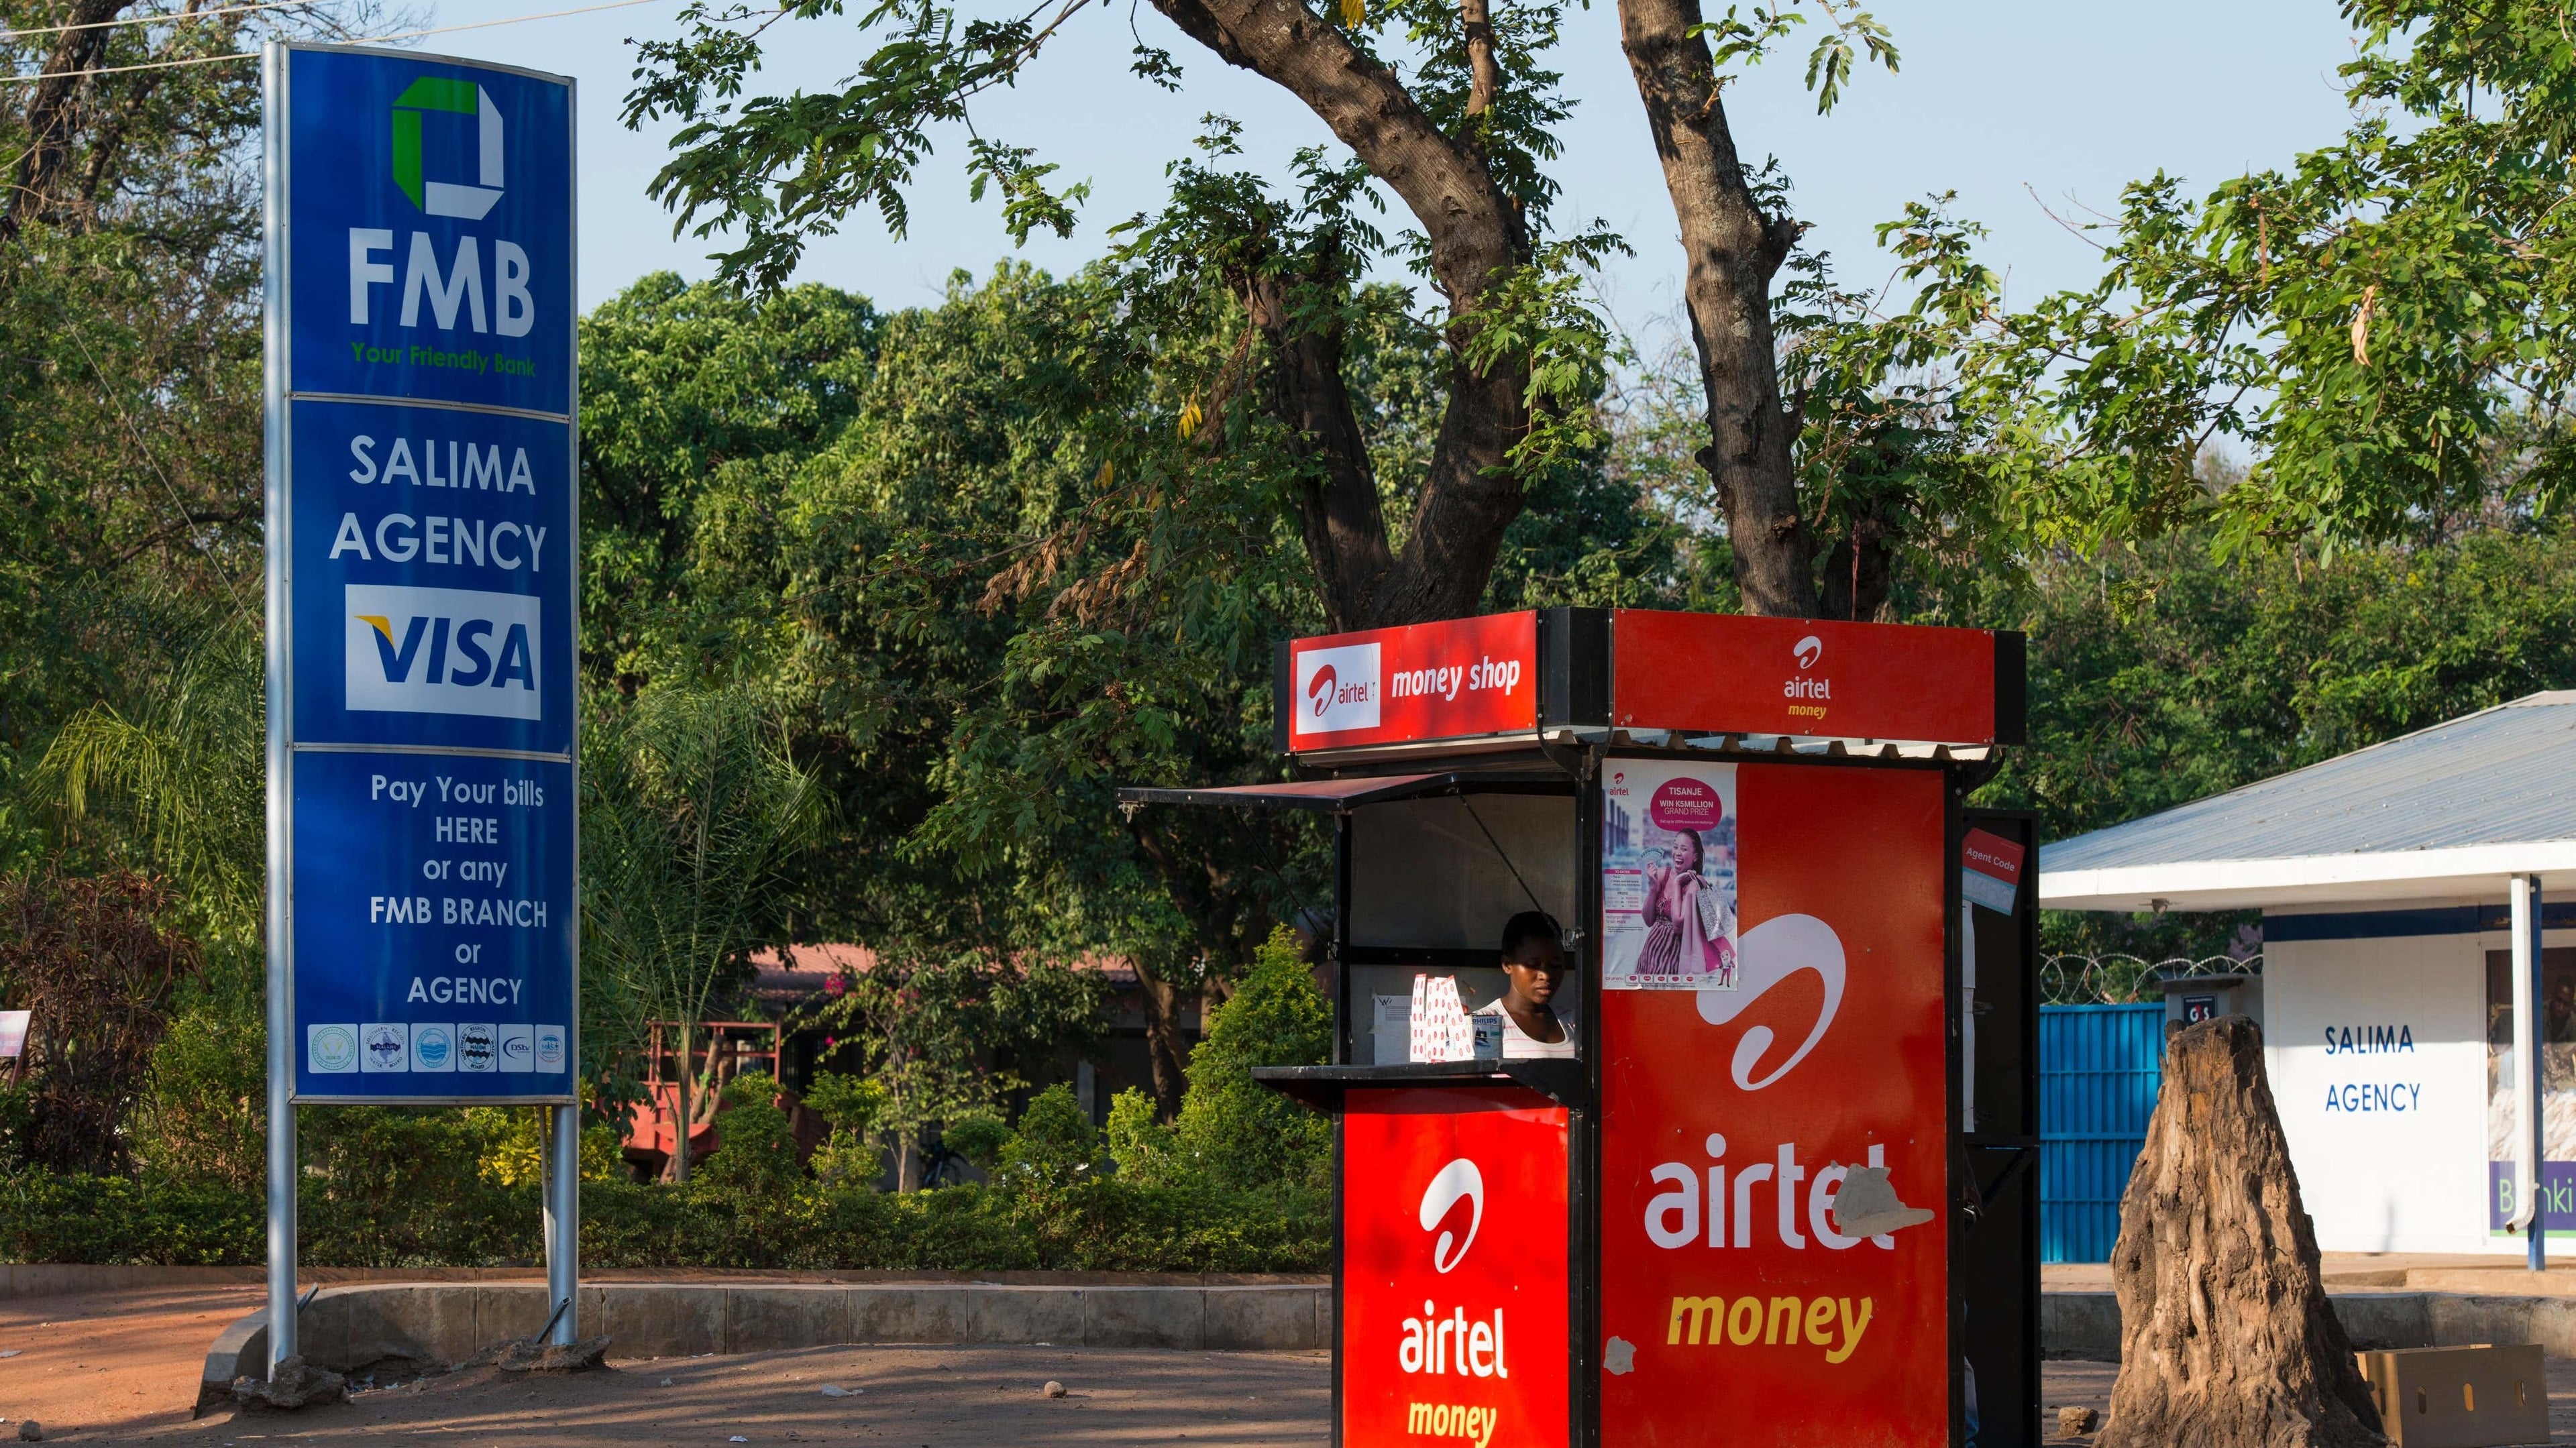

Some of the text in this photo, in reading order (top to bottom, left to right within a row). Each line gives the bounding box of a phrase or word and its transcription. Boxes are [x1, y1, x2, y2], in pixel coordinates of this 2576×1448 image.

[350, 227, 535, 337] FMB
[351, 342, 536, 377] Your Friendly Bank
[349, 435, 536, 495] SALIMA
[329, 512, 546, 572] AGENCY
[354, 615, 535, 691] VISA
[1338, 683, 1368, 704] airtel
[1391, 656, 1520, 702] money shop
[1784, 676, 1831, 699] airtel
[1788, 705, 1827, 720] money
[372, 775, 543, 807] Pay Your bills
[1609, 787, 1629, 796] airtel
[1669, 787, 1703, 795] TISANJE
[1675, 800, 1713, 808] K5MILLION
[436, 816, 498, 844] HERE
[423, 859, 507, 887] or any
[1966, 847, 2015, 871] Agent Code
[370, 896, 547, 928] FMB BRANCH
[455, 943, 481, 964] or
[407, 977, 522, 1005] AGENCY
[2325, 1025, 2414, 1054] SALIMA
[2326, 1083, 2420, 1112] AGENCY
[2500, 1178, 2573, 1213] Bnki
[1399, 1299, 1508, 1379] airtel
[1667, 1296, 1872, 1363] money
[1407, 1402, 1497, 1448] money
